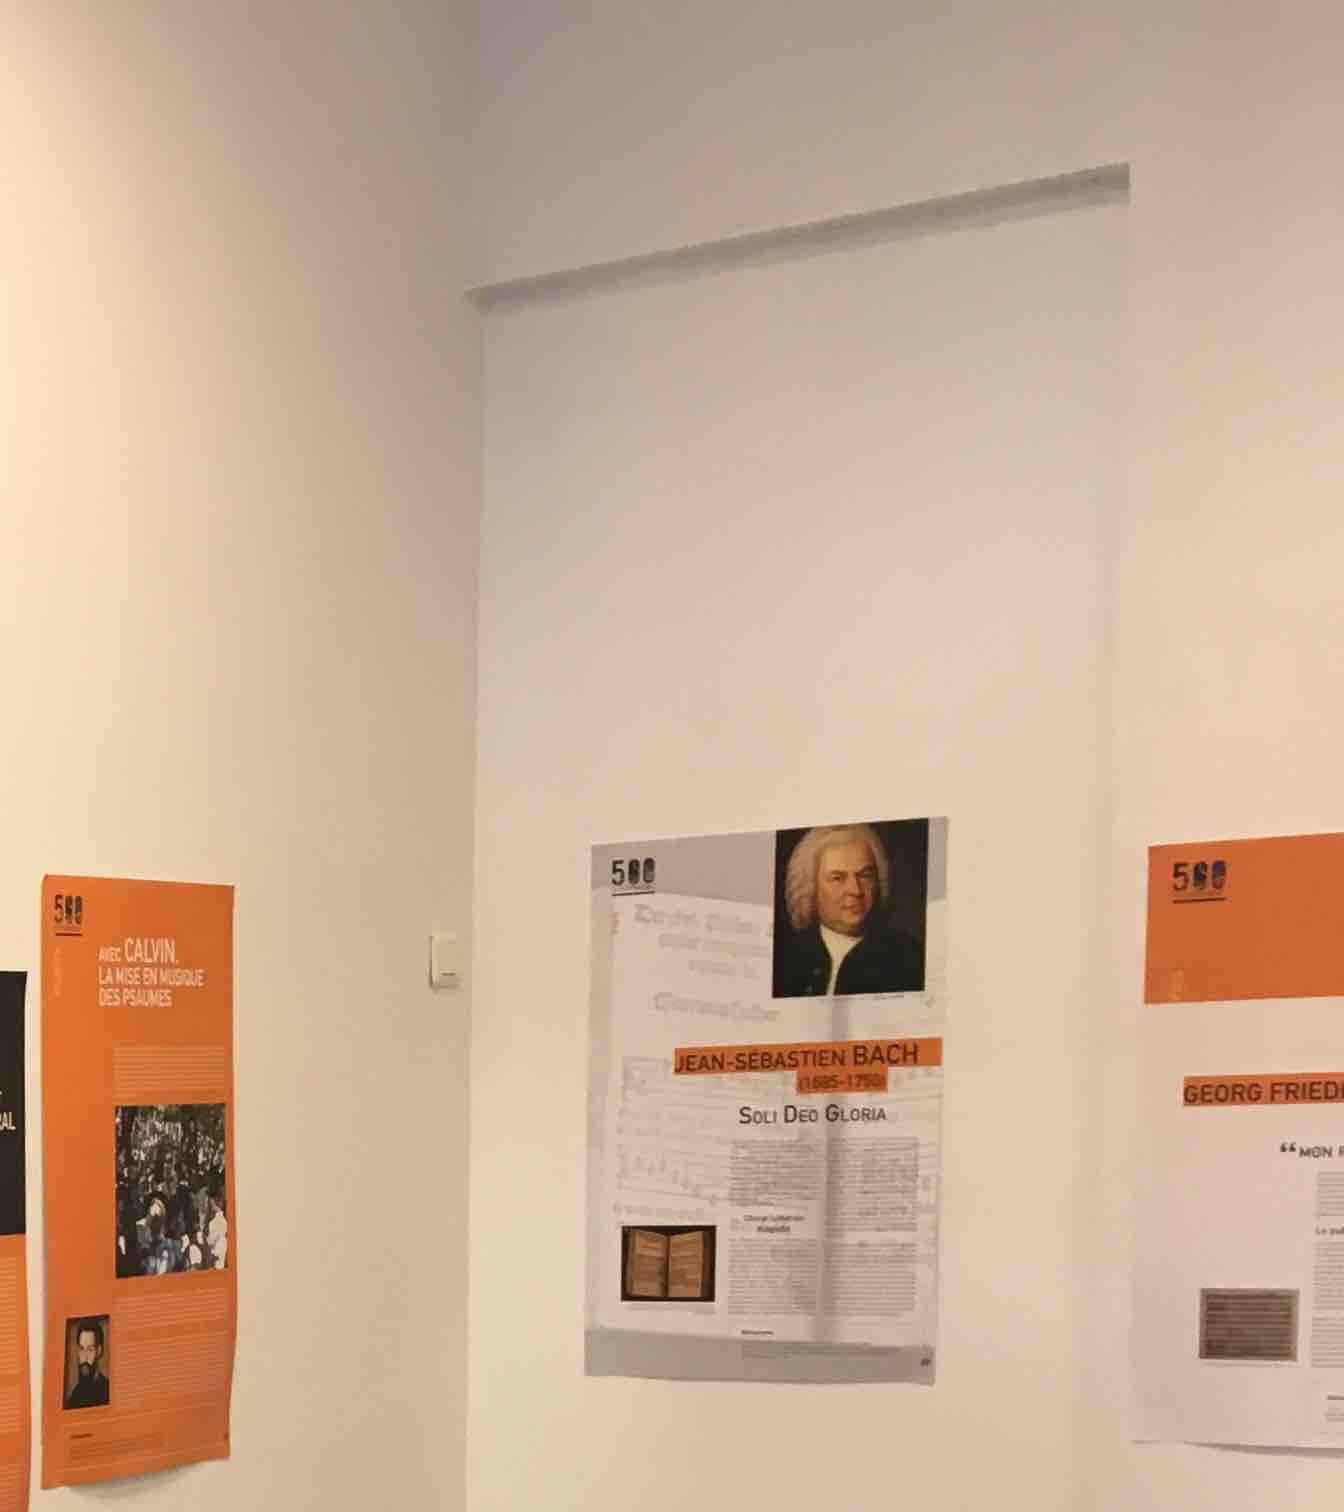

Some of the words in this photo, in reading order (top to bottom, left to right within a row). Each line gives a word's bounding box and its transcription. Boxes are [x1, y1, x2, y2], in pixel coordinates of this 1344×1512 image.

[98, 966, 112, 985] LA
[115, 967, 141, 985] MISE
[142, 967, 158, 985] EN
[98, 987, 120, 1008] DES
[122, 988, 173, 1008] PSAUMES
[853, 1043, 919, 1067] BACH
[1184, 1083, 1262, 1104] GEORG
[1270, 1080, 1344, 1101] FRIED
